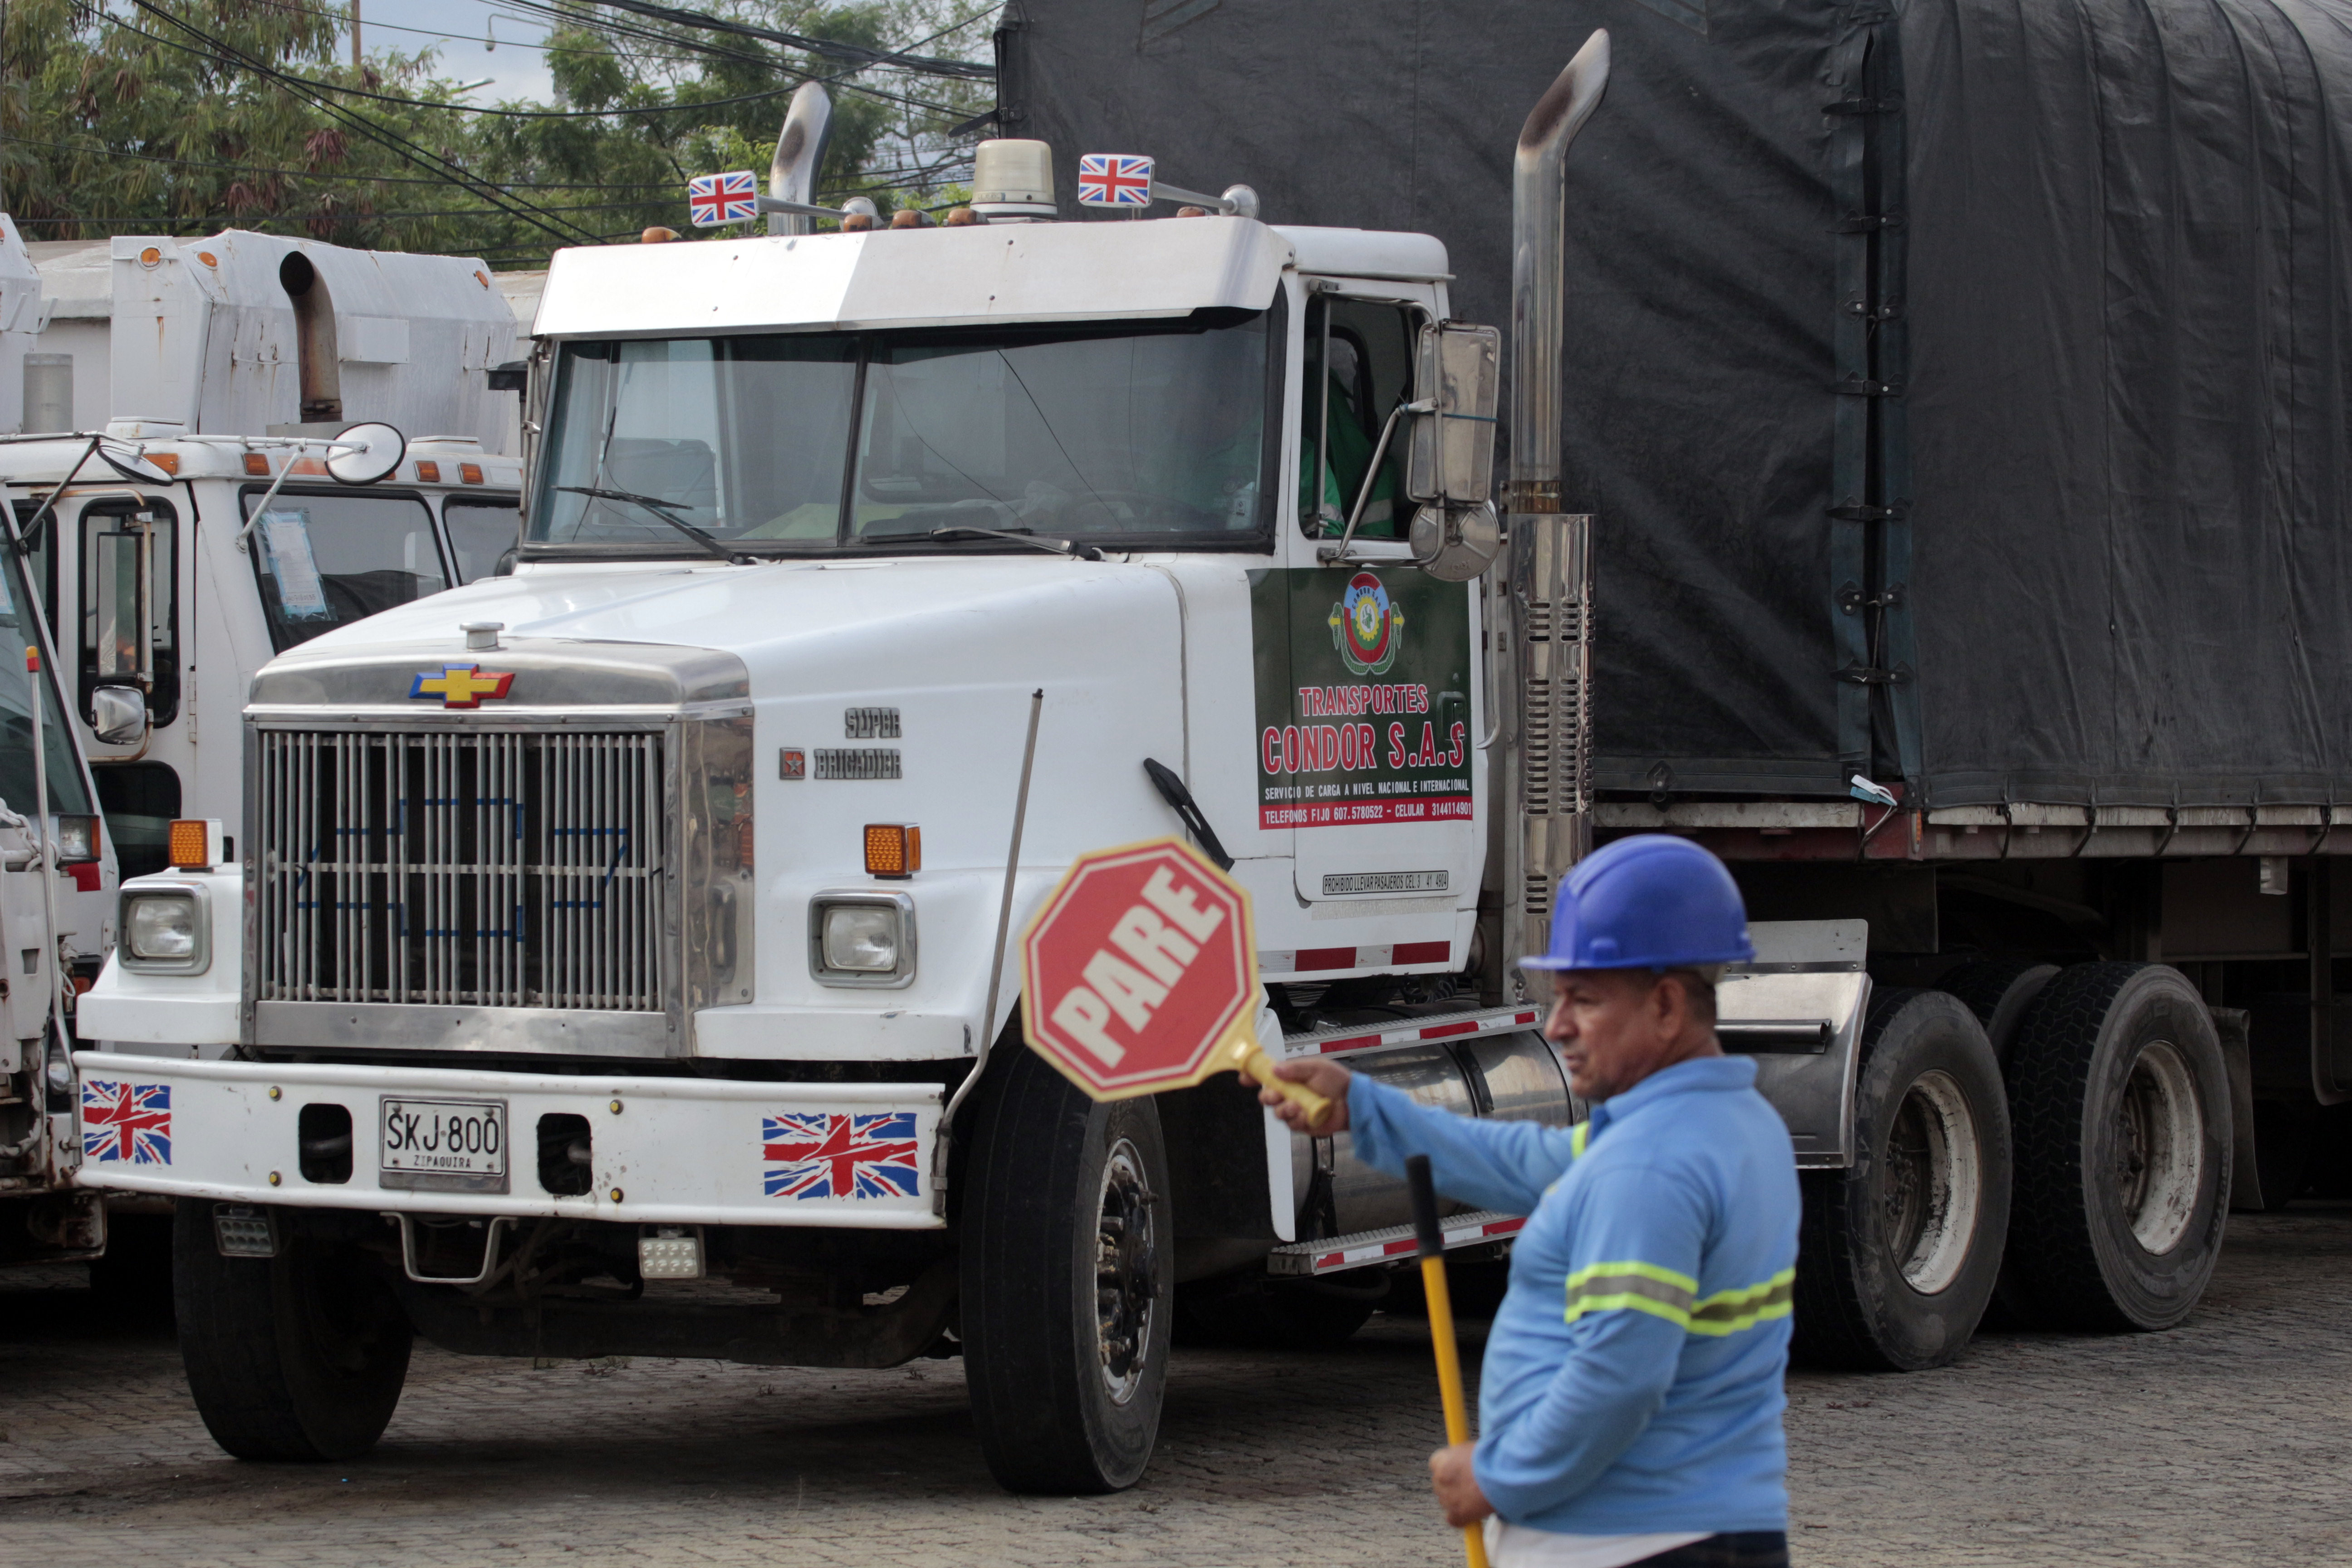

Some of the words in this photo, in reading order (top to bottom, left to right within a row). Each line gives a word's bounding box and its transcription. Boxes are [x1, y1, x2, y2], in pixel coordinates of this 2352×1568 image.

[1299, 684, 1429, 716] TRANSPORTES
[845, 707, 902, 738] SUPER
[1262, 722, 1377, 775] CONDOR
[1388, 721, 1465, 769] S.A.S
[813, 749, 902, 779] BRIGADIER
[1265, 786, 1301, 800] SERVICIO
[1305, 786, 1314, 798] DE
[1318, 784, 1341, 797] CARGA
[1344, 784, 1349, 795] A
[1353, 783, 1374, 795] NIVEL
[1378, 781, 1411, 794] NACIONAL
[1413, 781, 1417, 793] E
[1420, 779, 1469, 792] INTERNACIONAL
[1265, 809, 1307, 824] TELEFONOS
[1312, 808, 1330, 822] FIJO
[1334, 805, 1383, 820] 607.5780522
[1395, 804, 1424, 817] CELULAR
[1432, 802, 1471, 816] 3144114901
[1325, 877, 1353, 892] PROHIBIDO
[1354, 876, 1373, 890] LLEVAR
[1374, 875, 1403, 890] PASAJEROS
[1050, 864, 1226, 1069] PARE
